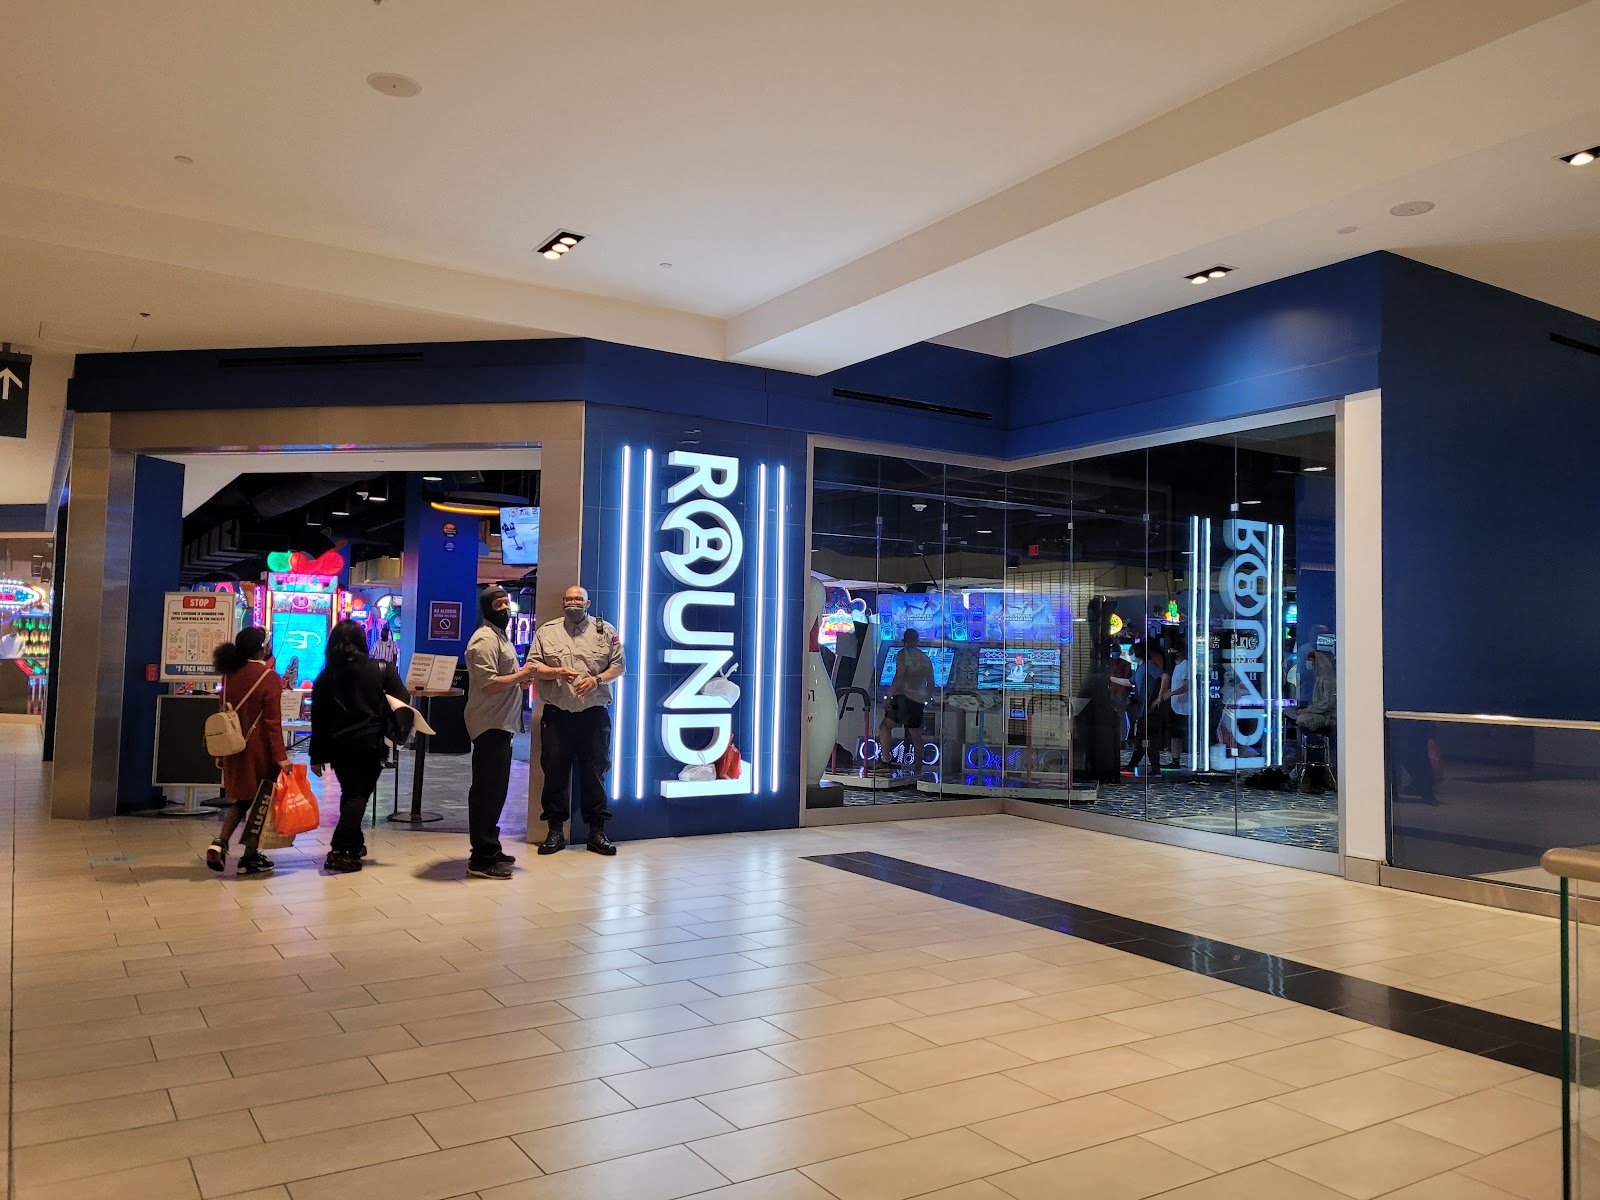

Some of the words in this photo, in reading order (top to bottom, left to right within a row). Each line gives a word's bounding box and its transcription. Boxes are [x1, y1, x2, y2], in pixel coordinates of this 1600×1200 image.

[189, 598, 210, 607] STOP
[182, 665, 197, 673] FACE
[251, 794, 271, 835] LUSH
